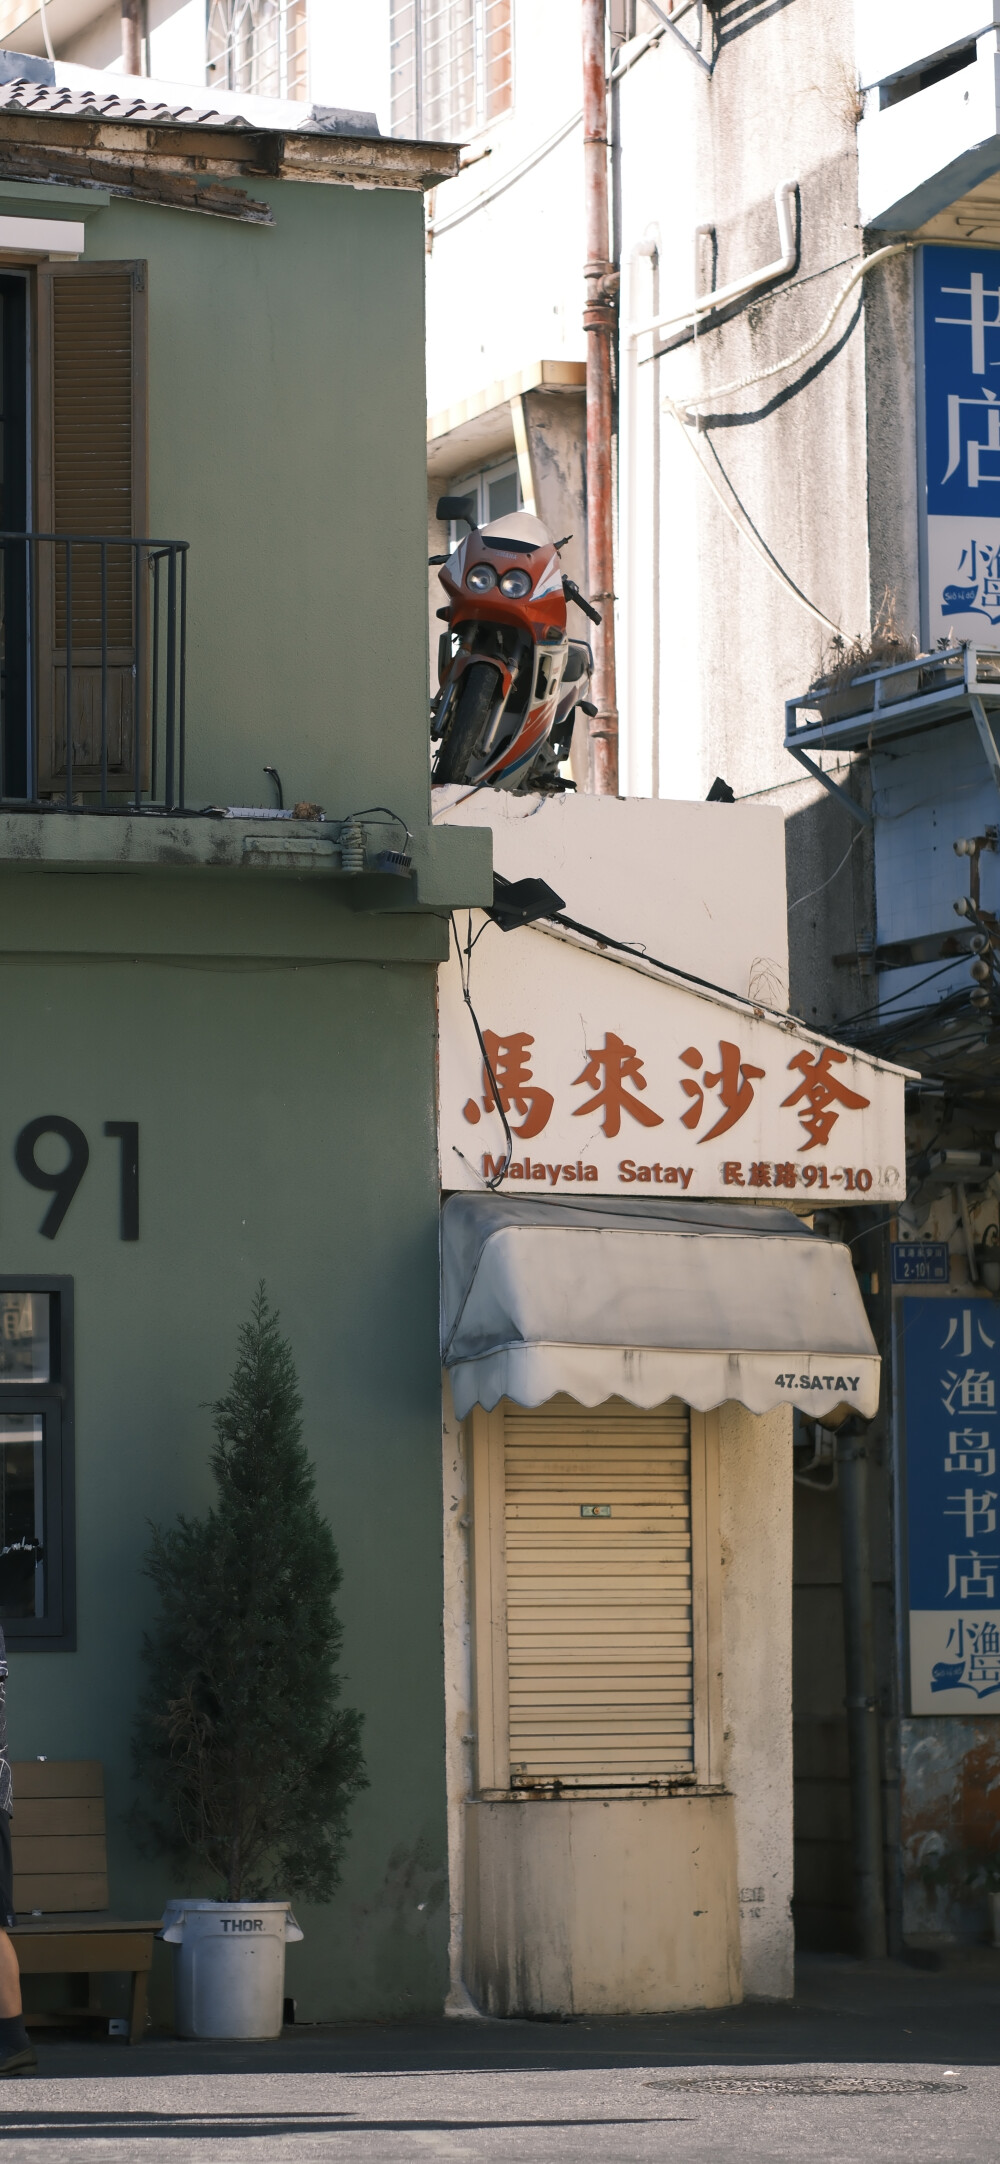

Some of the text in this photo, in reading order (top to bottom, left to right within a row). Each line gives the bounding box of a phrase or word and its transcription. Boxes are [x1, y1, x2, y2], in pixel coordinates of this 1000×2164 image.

[463, 1029, 870, 1152] 馬來沙爹
[14, 1115, 139, 1241] 91
[482, 1154, 598, 1186] Malaysia
[619, 1159, 694, 1190] Satay
[774, 1373, 860, 1391] 47.SATAY
[939, 1309, 1000, 1600] 小渔岛书店
